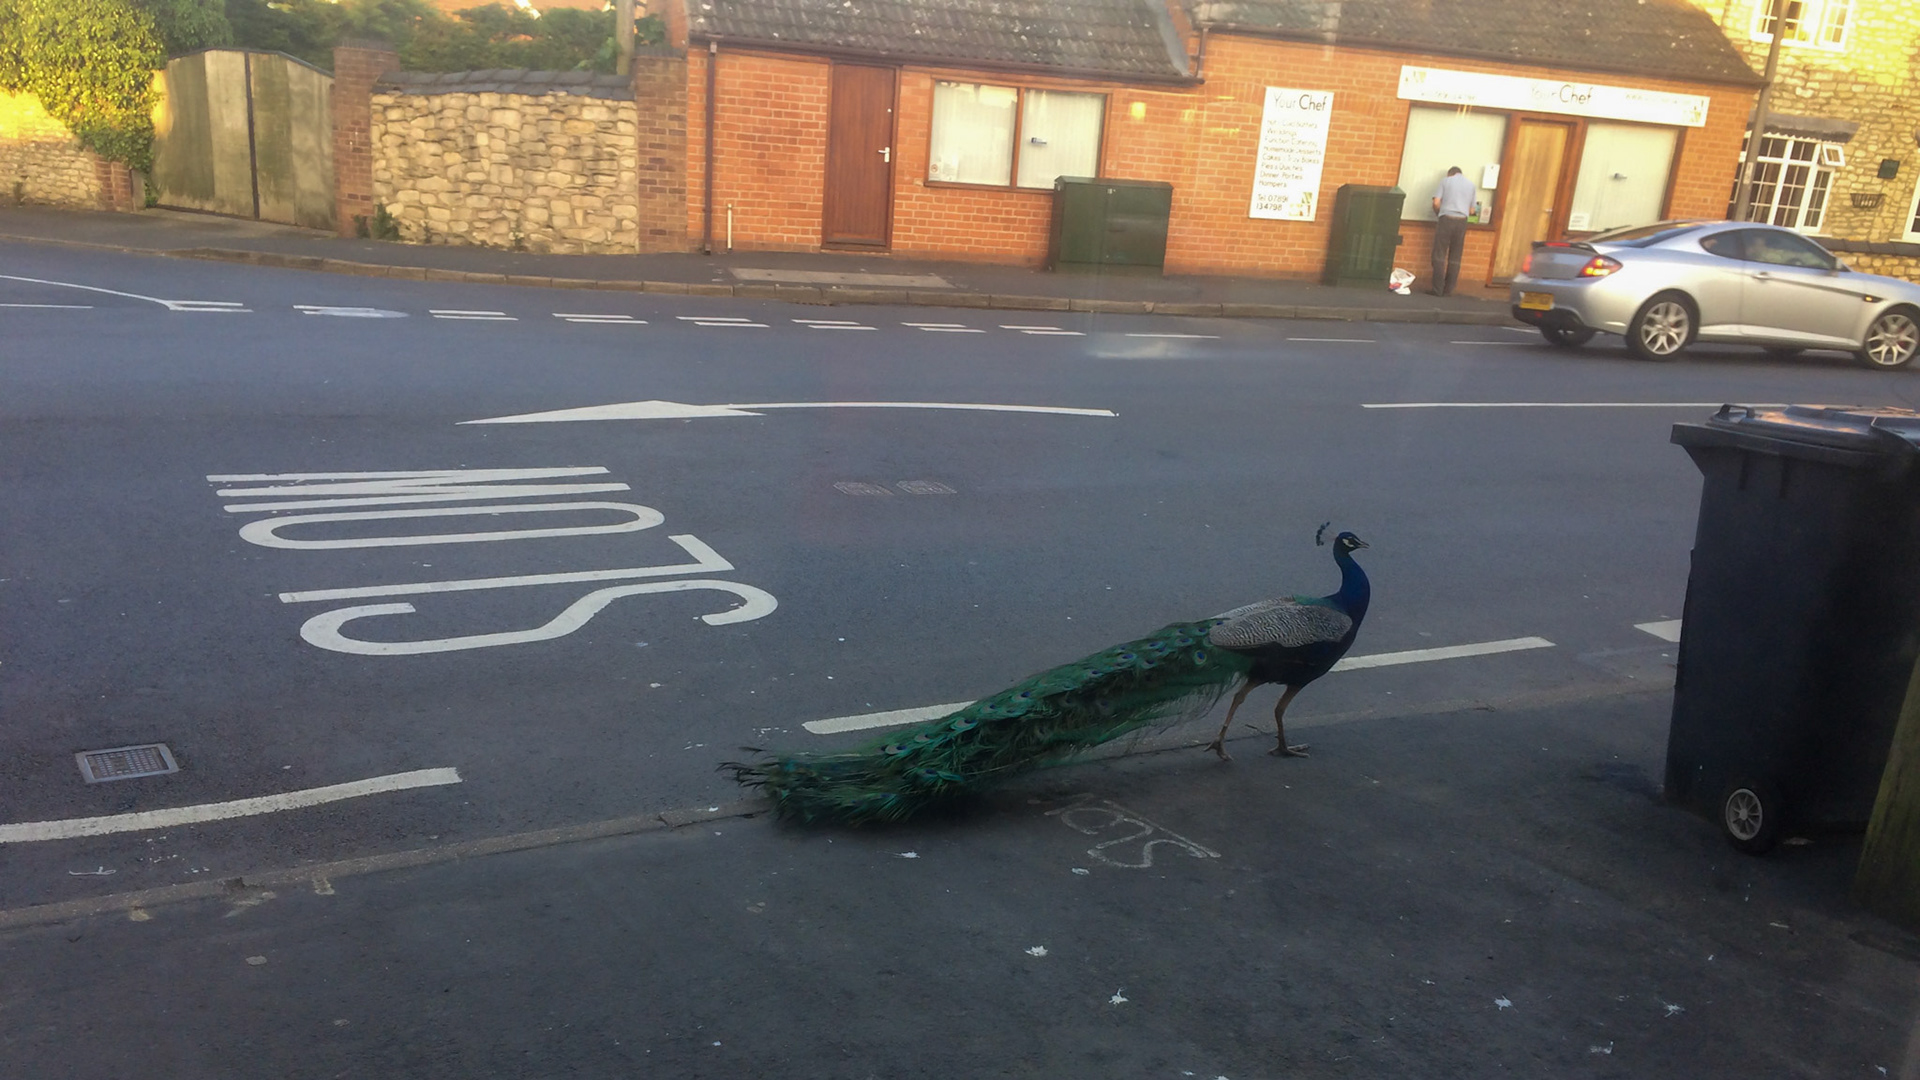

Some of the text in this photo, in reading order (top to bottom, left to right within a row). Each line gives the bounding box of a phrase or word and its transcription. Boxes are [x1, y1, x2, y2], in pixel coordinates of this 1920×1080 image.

[1273, 91, 1328, 111] Your Chef
[1560, 83, 1594, 105] Chef
[206, 466, 778, 655] SLOW
